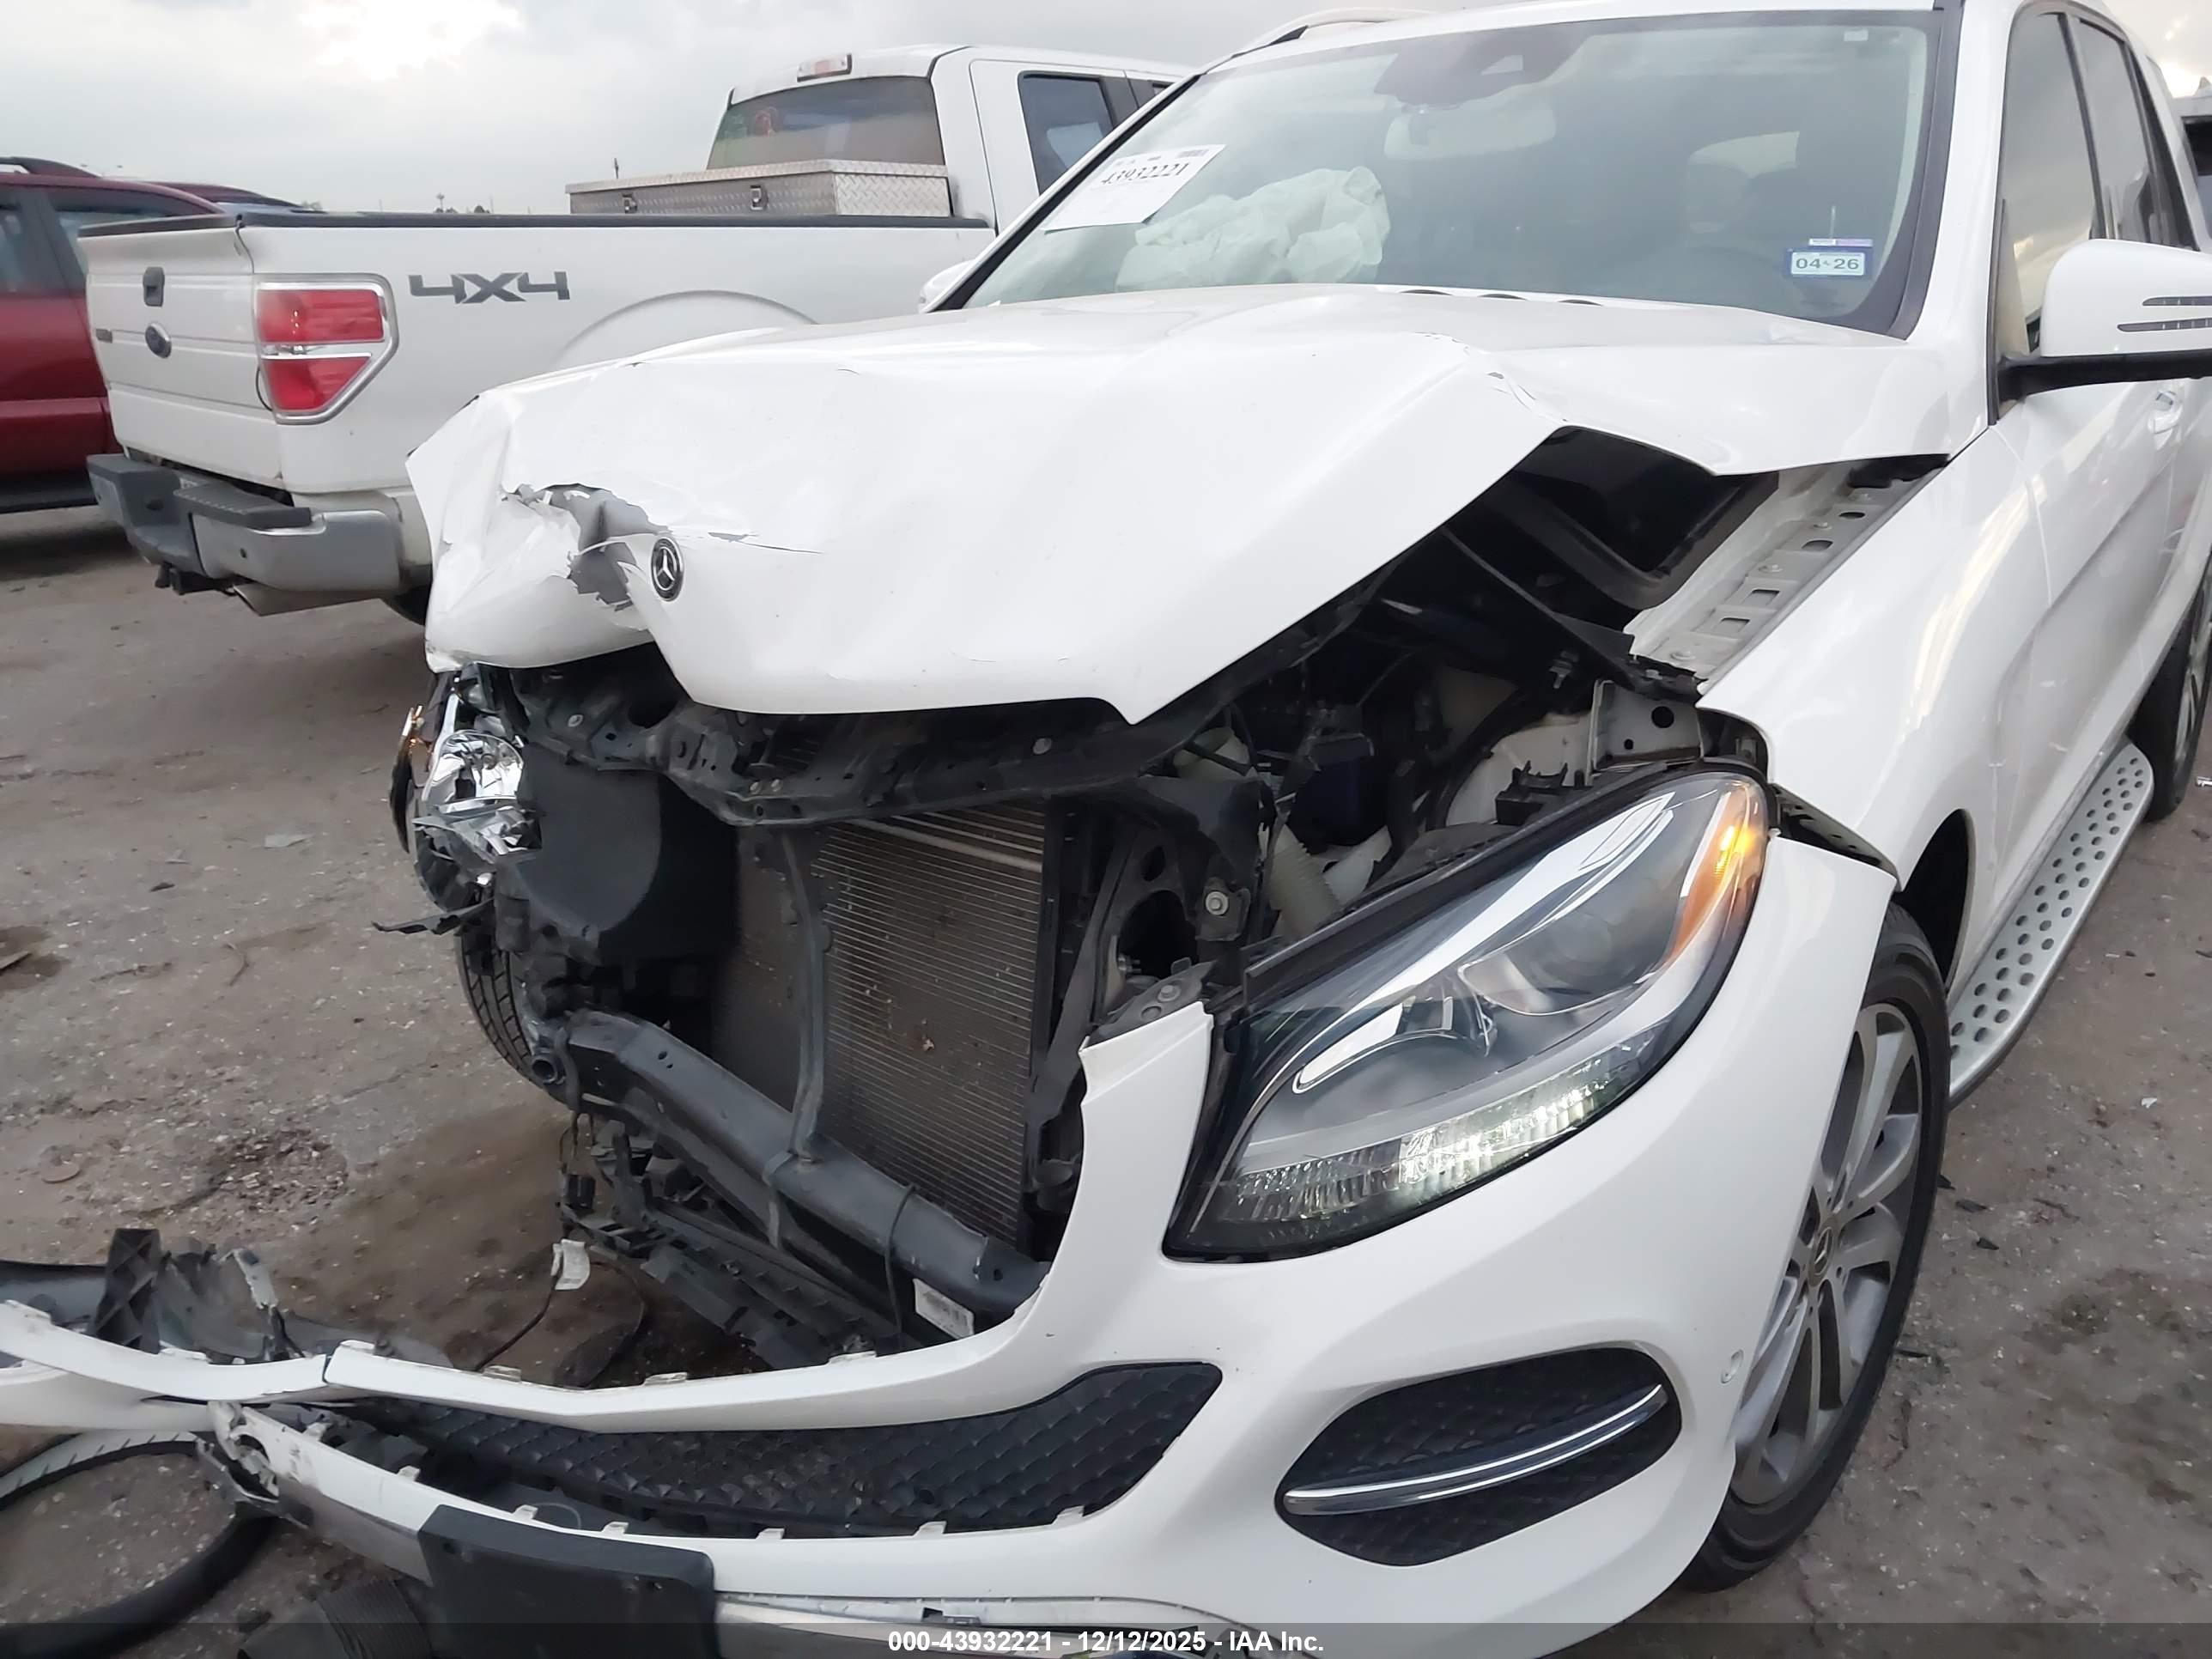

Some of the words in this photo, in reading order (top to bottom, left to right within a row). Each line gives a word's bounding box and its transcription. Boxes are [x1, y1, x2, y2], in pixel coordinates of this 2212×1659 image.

[1796, 258, 1821, 269] 04
[1833, 258, 1859, 270] 26
[408, 271, 570, 304] 4X4
